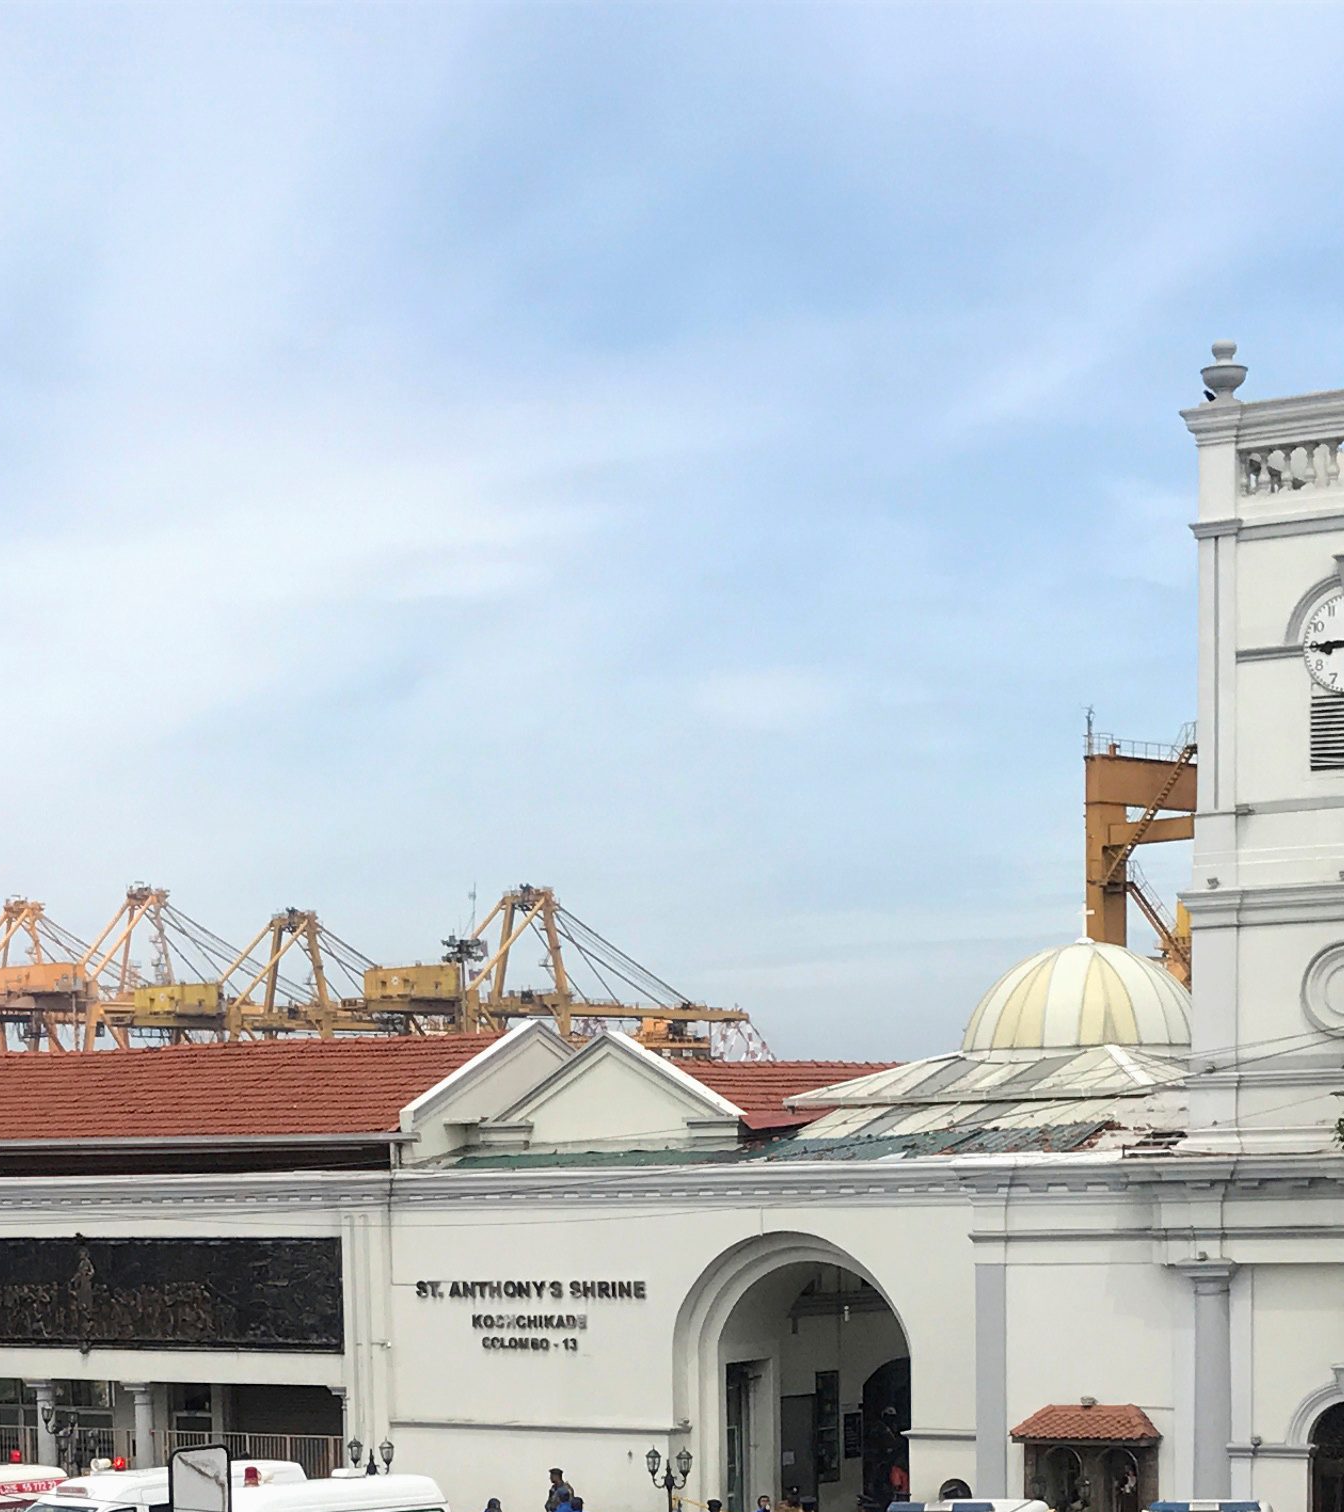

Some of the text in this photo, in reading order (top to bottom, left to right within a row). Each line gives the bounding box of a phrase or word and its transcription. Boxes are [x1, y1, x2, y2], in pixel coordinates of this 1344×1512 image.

[1311, 620, 1325, 633] 10
[1315, 659, 1324, 672] 8
[1329, 672, 1338, 685] 7
[415, 1280, 647, 1300] ST. ANTHONY'S SHRINE
[481, 1336, 550, 1352] COLOMBO
[562, 1337, 579, 1352] 13
